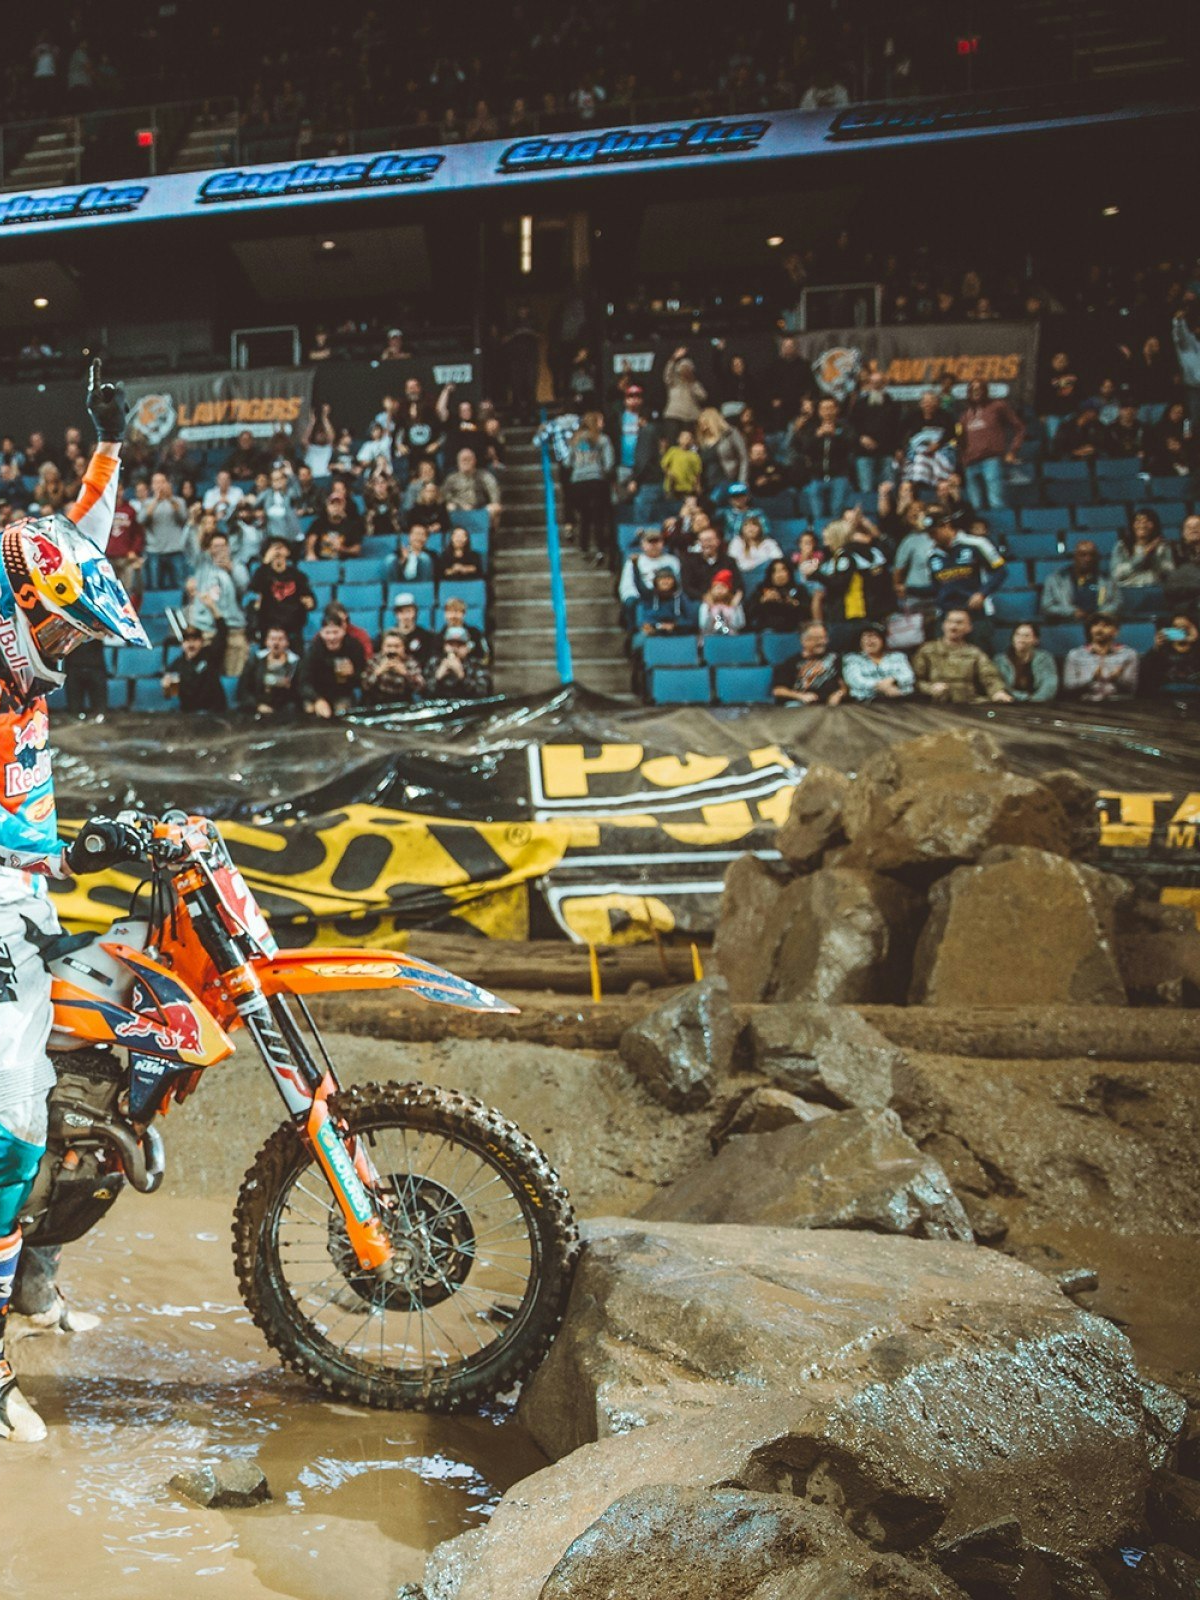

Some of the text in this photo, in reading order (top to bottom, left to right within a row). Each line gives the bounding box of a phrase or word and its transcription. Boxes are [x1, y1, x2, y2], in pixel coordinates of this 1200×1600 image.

[502, 129, 686, 164] Engine
[685, 120, 771, 147] Ice
[77, 186, 149, 210] Ice
[200, 162, 368, 198] Engine
[367, 155, 445, 181] Ice
[134, 1059, 166, 1076] KTM
[329, 1149, 373, 1219] MOTOREX
